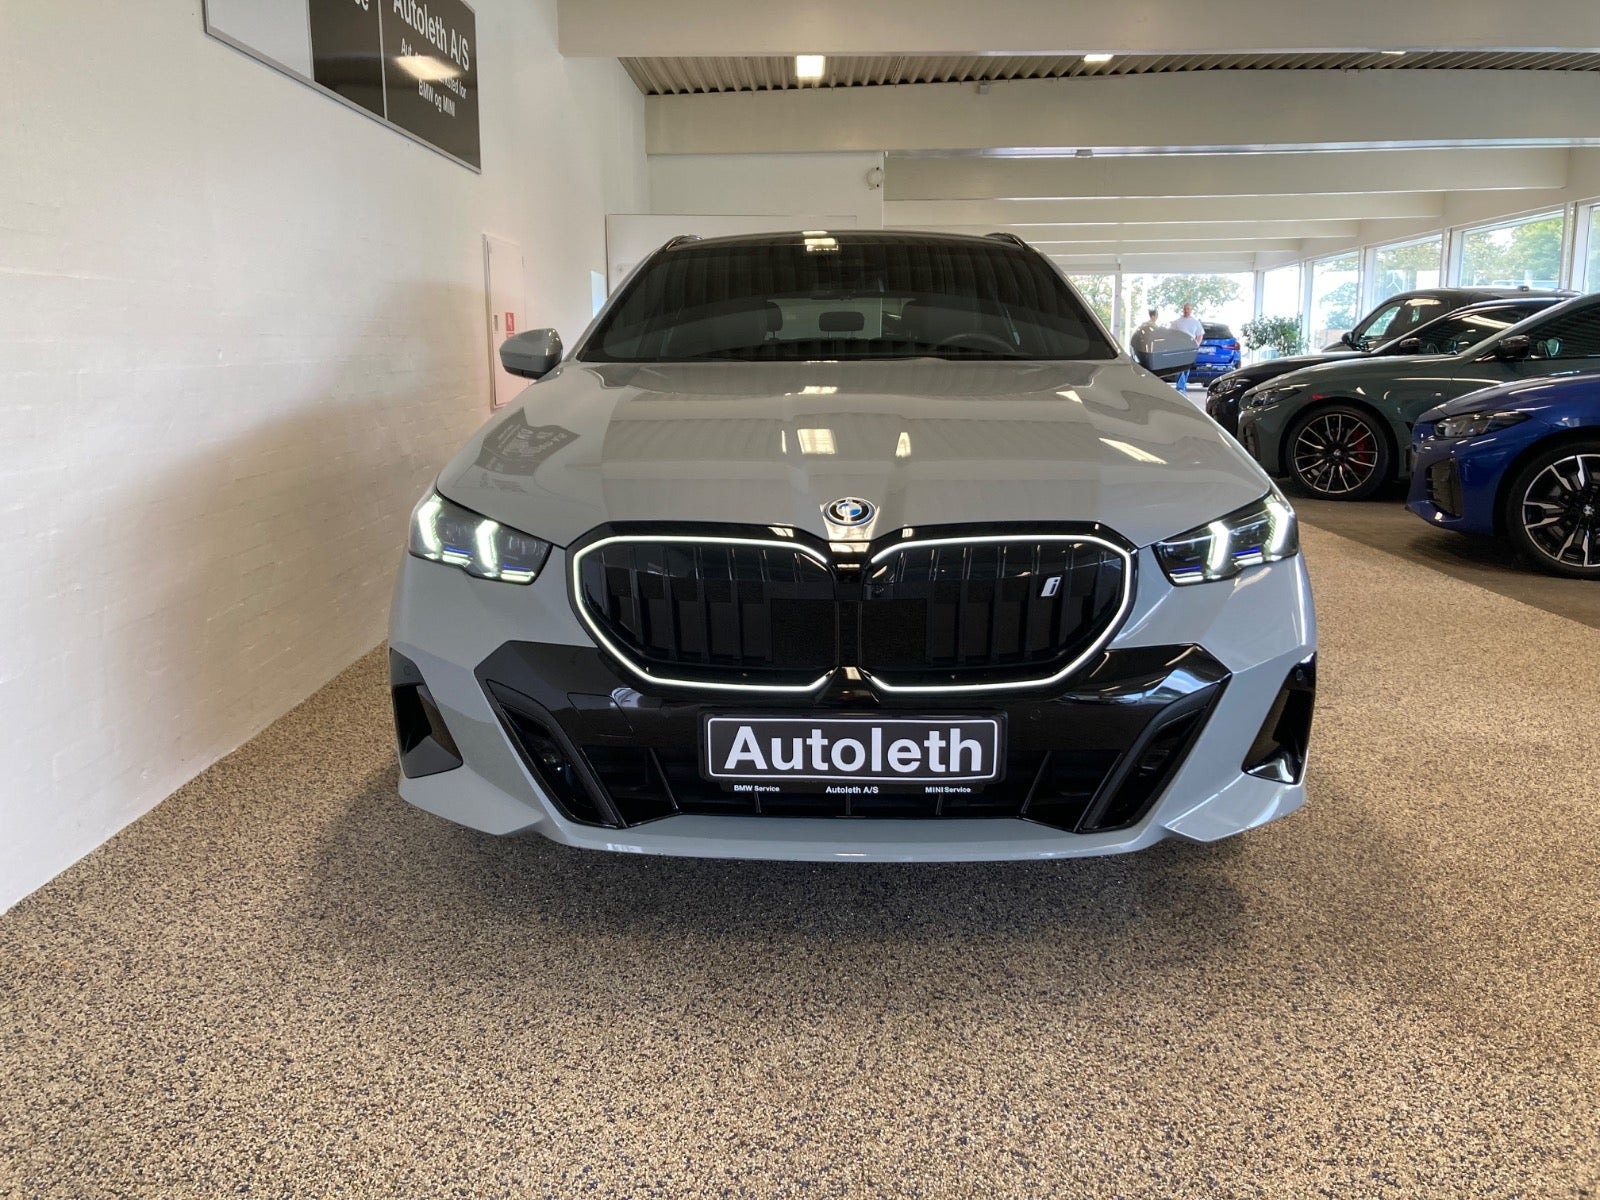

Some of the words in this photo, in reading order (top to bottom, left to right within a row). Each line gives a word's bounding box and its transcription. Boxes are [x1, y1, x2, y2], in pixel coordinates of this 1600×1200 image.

[393, 0, 448, 54] Autoleth
[450, 28, 470, 72] A/S
[442, 96, 456, 118] MINI
[724, 726, 982, 773] Autoleth
[733, 784, 753, 793] BMW
[754, 784, 780, 793] Service
[825, 785, 862, 794] Autoleth
[862, 786, 879, 795] A/S
[925, 786, 944, 794] MINI
[944, 786, 971, 794] Service
